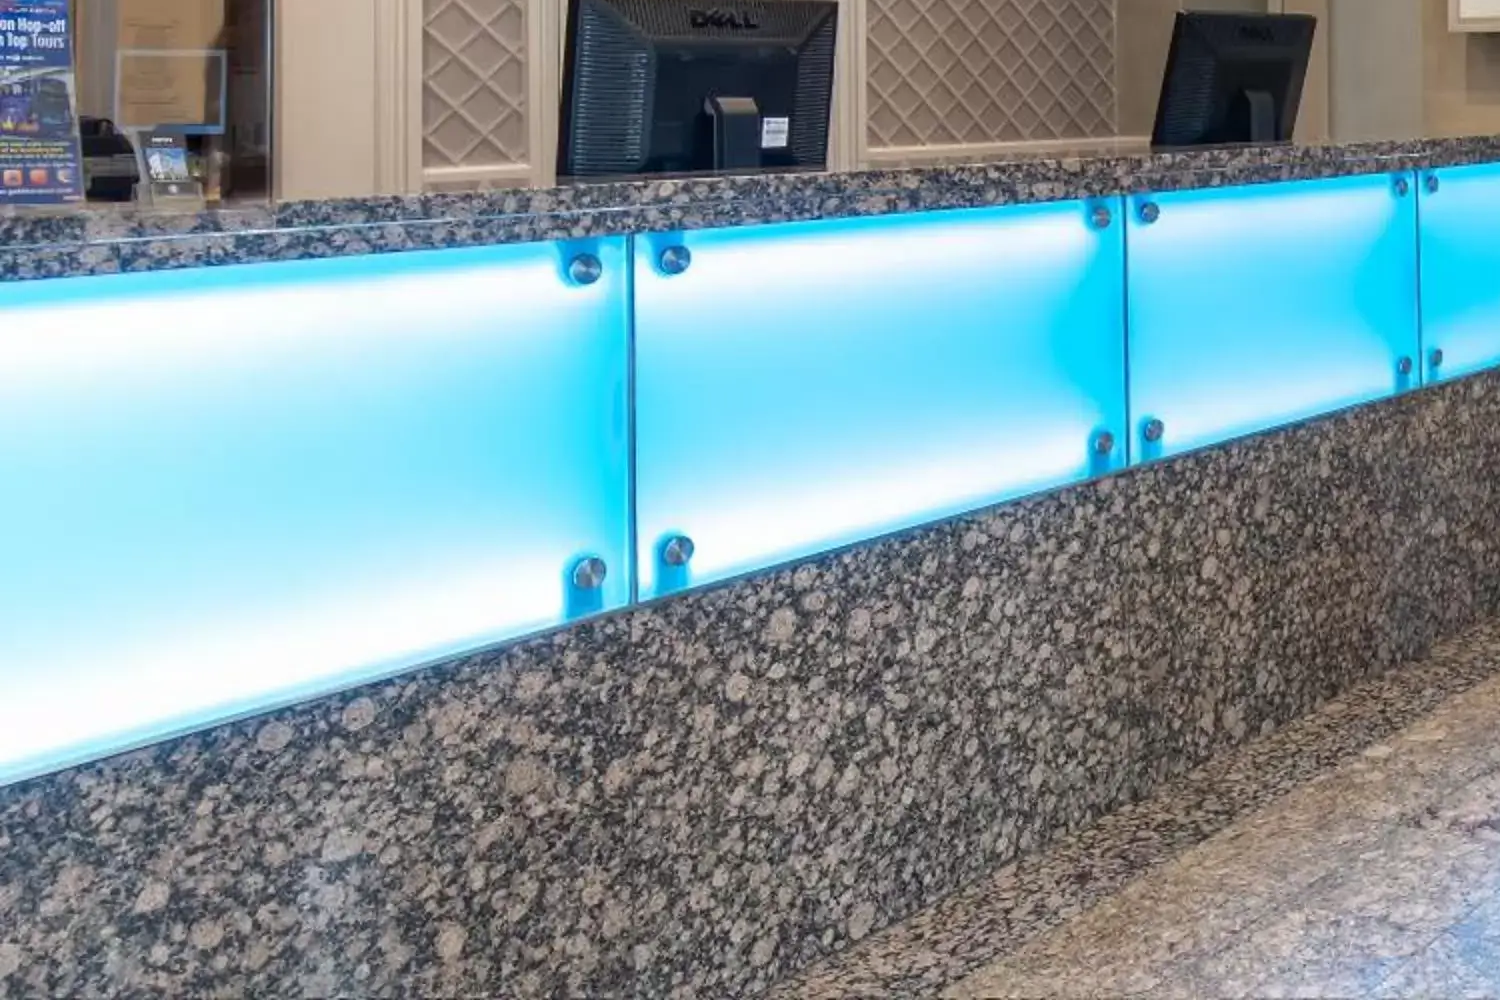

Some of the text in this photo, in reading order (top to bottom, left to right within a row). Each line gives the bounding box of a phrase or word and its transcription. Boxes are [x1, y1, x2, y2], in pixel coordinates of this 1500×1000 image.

[18, 18, 65, 33] Hop-off
[690, 9, 759, 29] DELL
[7, 32, 28, 51] Top
[31, 33, 65, 49] Tours
